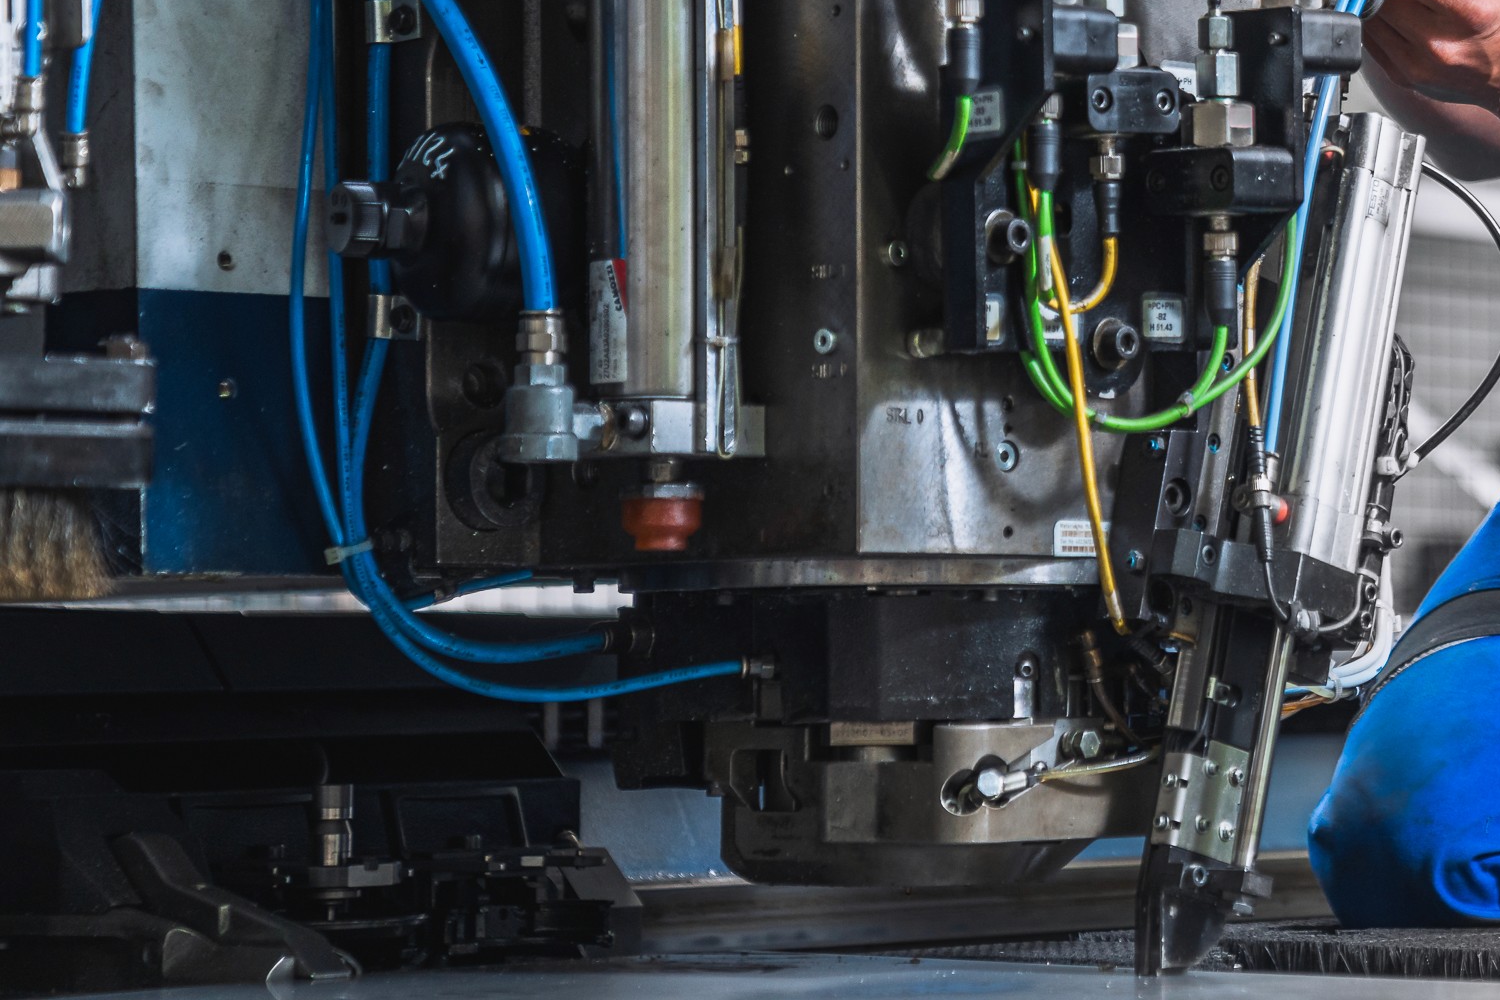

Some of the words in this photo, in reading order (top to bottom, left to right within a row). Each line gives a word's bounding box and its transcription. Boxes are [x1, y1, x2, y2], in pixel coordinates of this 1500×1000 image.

[1368, 179, 1380, 217] FESTO
[606, 264, 623, 312] CAMOZZI
[1150, 323, 1155, 331] H
